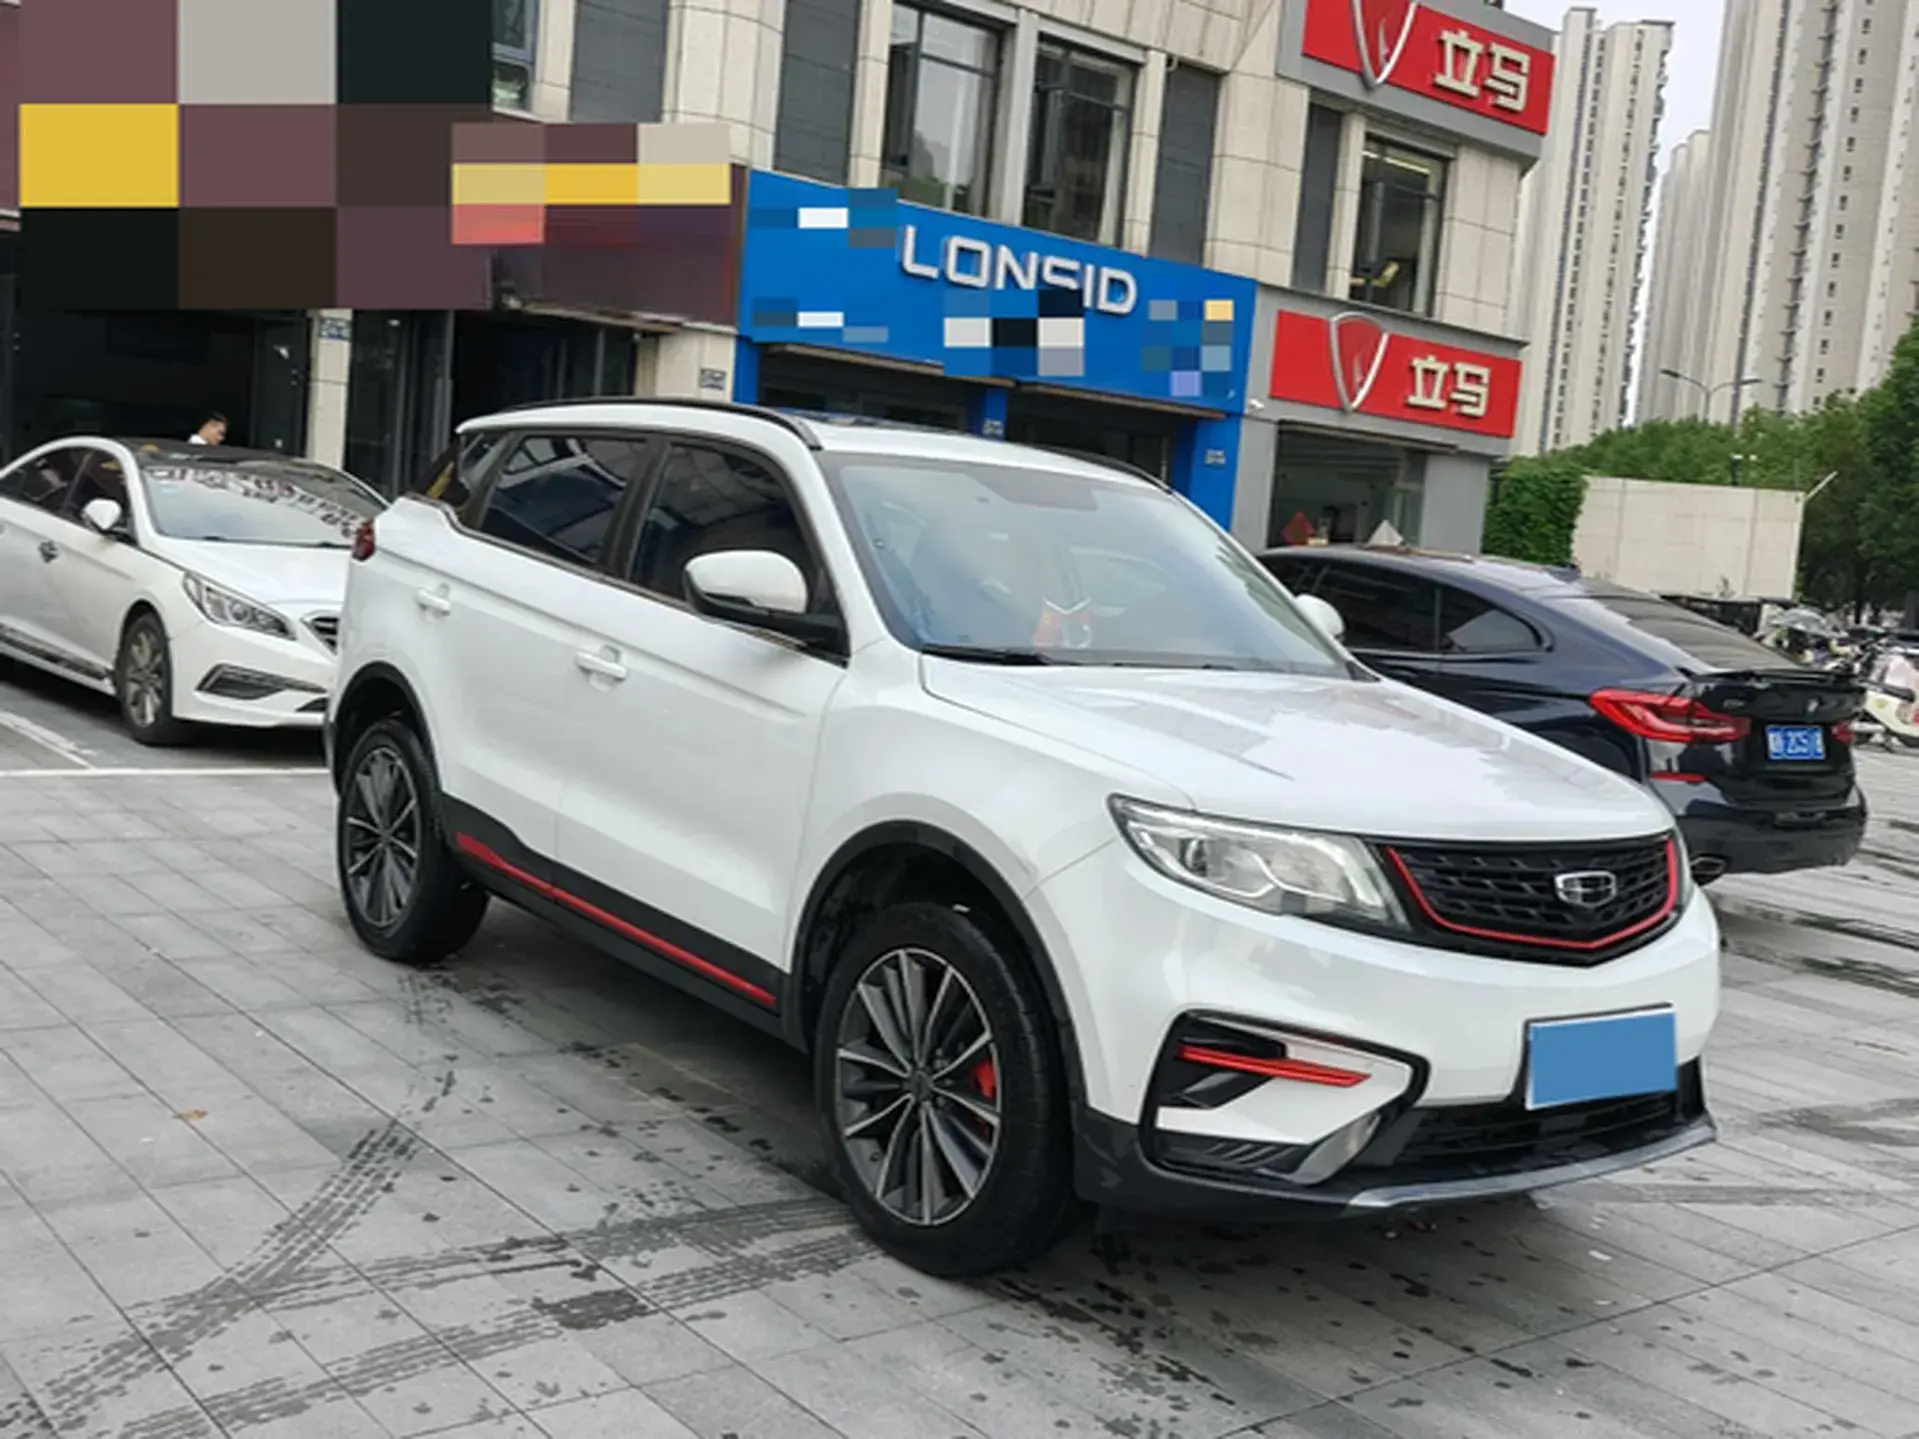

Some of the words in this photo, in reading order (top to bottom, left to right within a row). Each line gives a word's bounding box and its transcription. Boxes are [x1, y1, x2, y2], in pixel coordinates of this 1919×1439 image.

[1433, 28, 1531, 113] 立马
[900, 224, 1137, 314] LONSID
[1406, 353, 1490, 417] 立马
